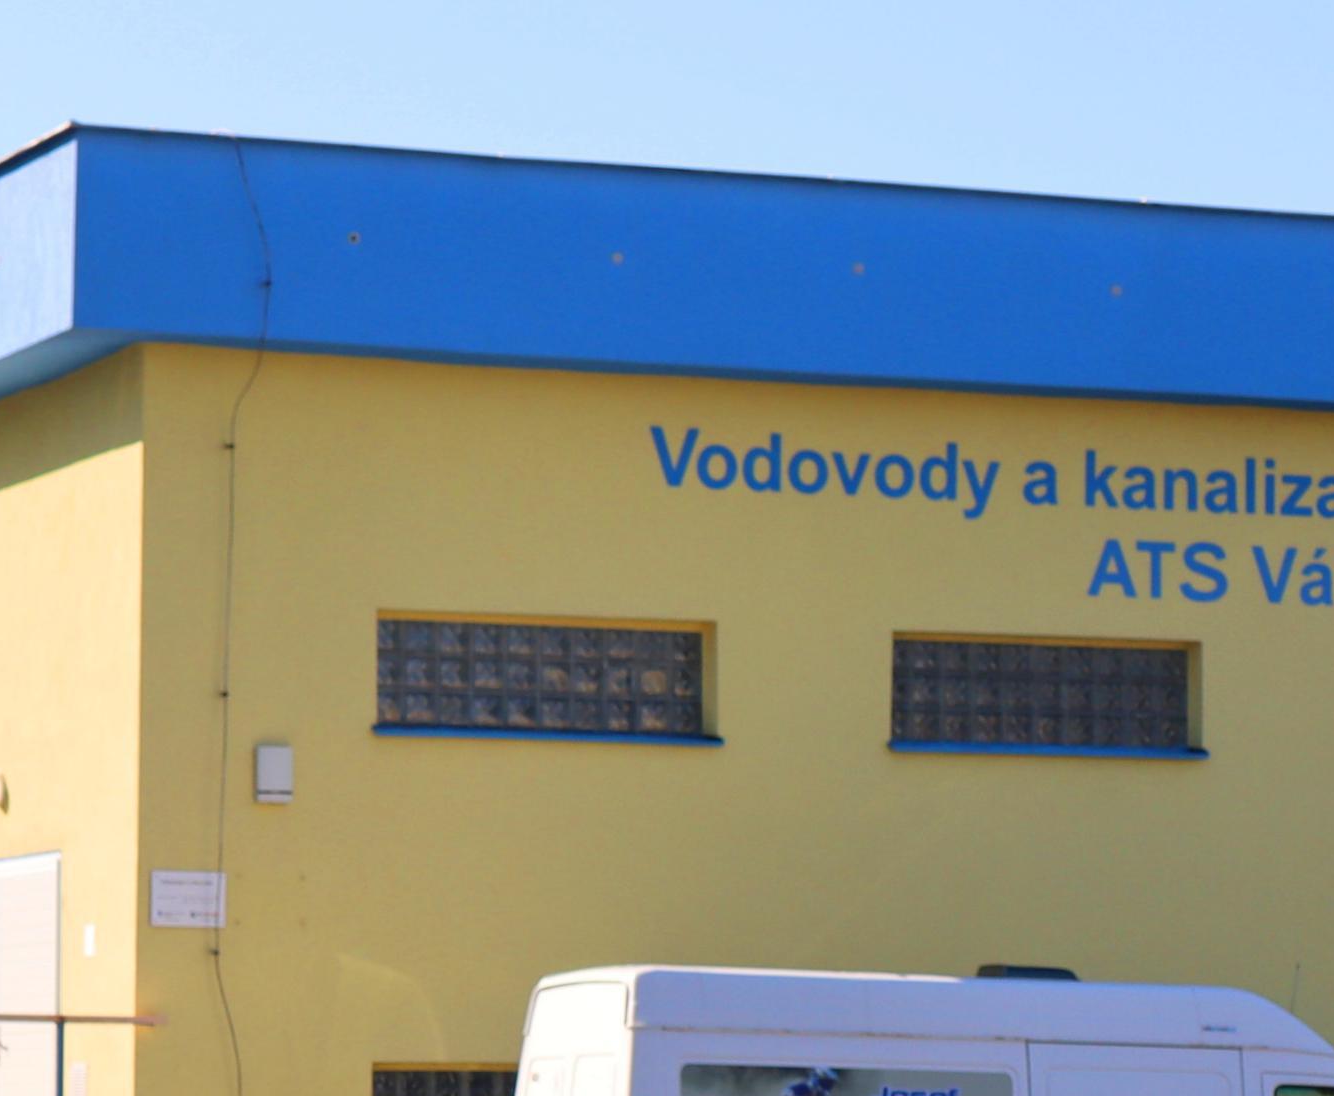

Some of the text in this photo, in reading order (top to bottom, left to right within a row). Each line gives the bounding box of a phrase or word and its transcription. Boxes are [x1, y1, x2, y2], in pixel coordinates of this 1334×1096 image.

[651, 426, 1000, 520] Vodovody
[1022, 460, 1059, 506] a
[1087, 538, 1229, 604] ATS
